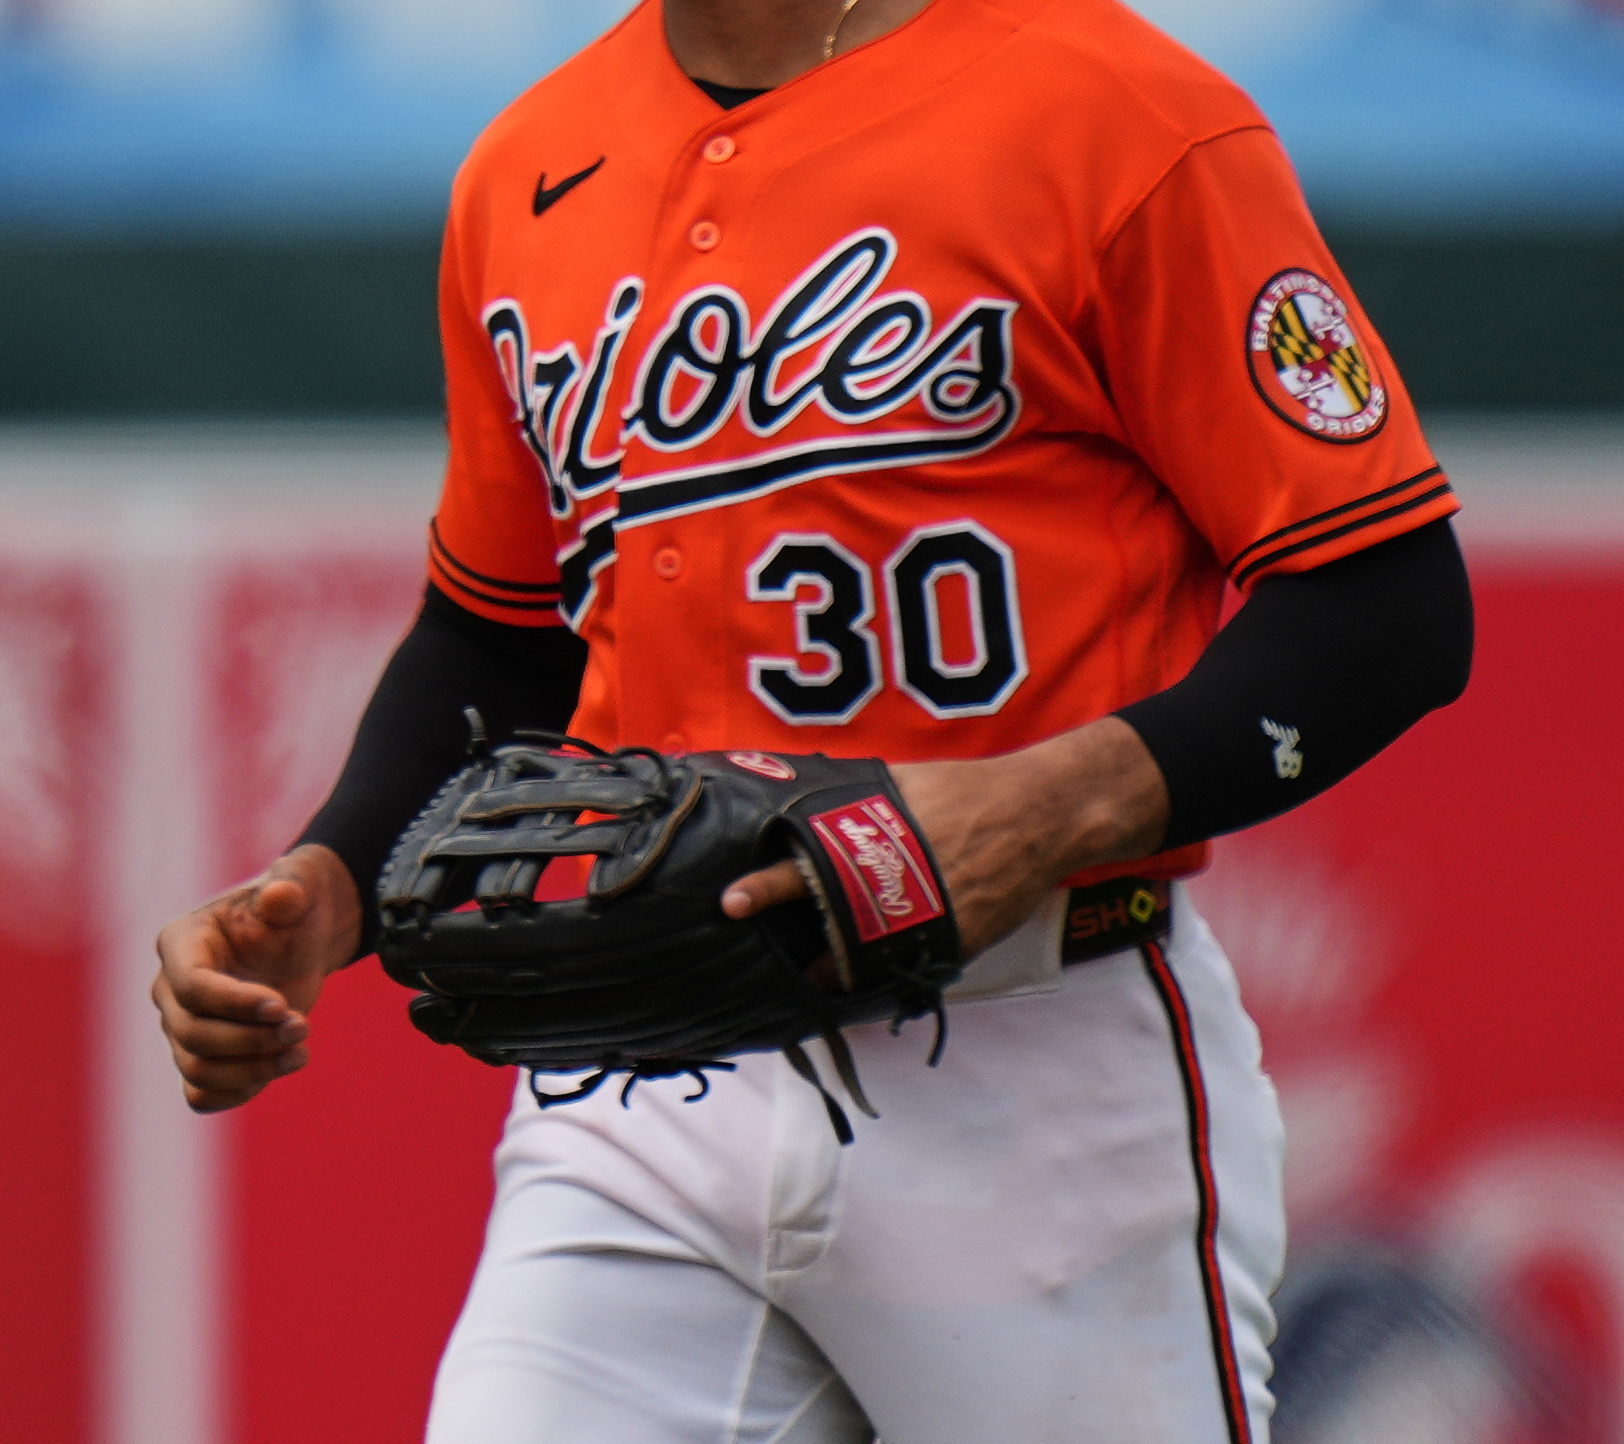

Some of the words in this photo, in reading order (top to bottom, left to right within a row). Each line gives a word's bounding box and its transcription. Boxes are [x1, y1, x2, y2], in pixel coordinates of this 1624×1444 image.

[481, 226, 1023, 521] Orioles
[1250, 272, 1348, 352] BALTIMORE
[1306, 385, 1385, 436] ORIOLES
[744, 518, 1030, 727] 30
